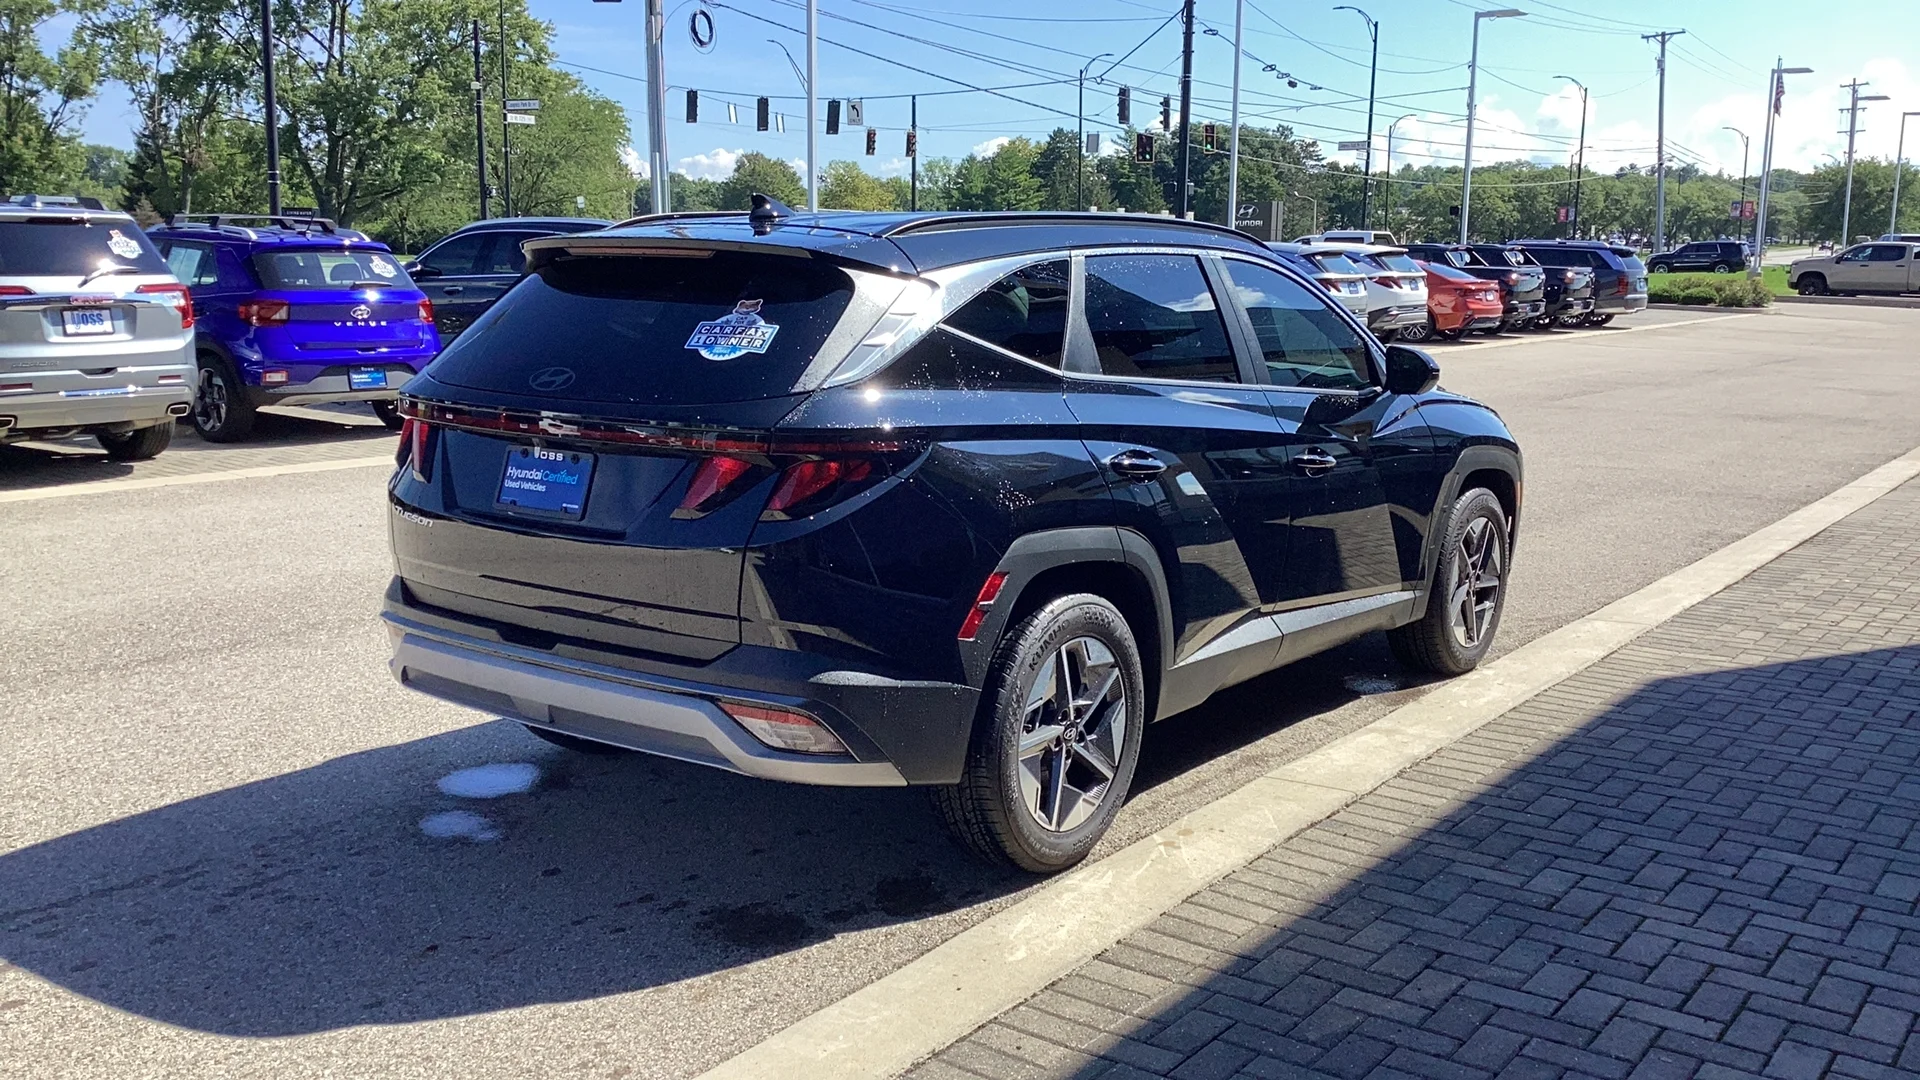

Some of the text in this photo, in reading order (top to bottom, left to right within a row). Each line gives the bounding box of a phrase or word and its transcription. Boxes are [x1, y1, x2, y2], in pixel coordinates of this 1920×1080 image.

[701, 326, 769, 338] CARFAX
[507, 466, 578, 484] Hyundai Certified
[504, 479, 546, 492] Used Vehicles
[1028, 619, 1071, 671] KUMHO
